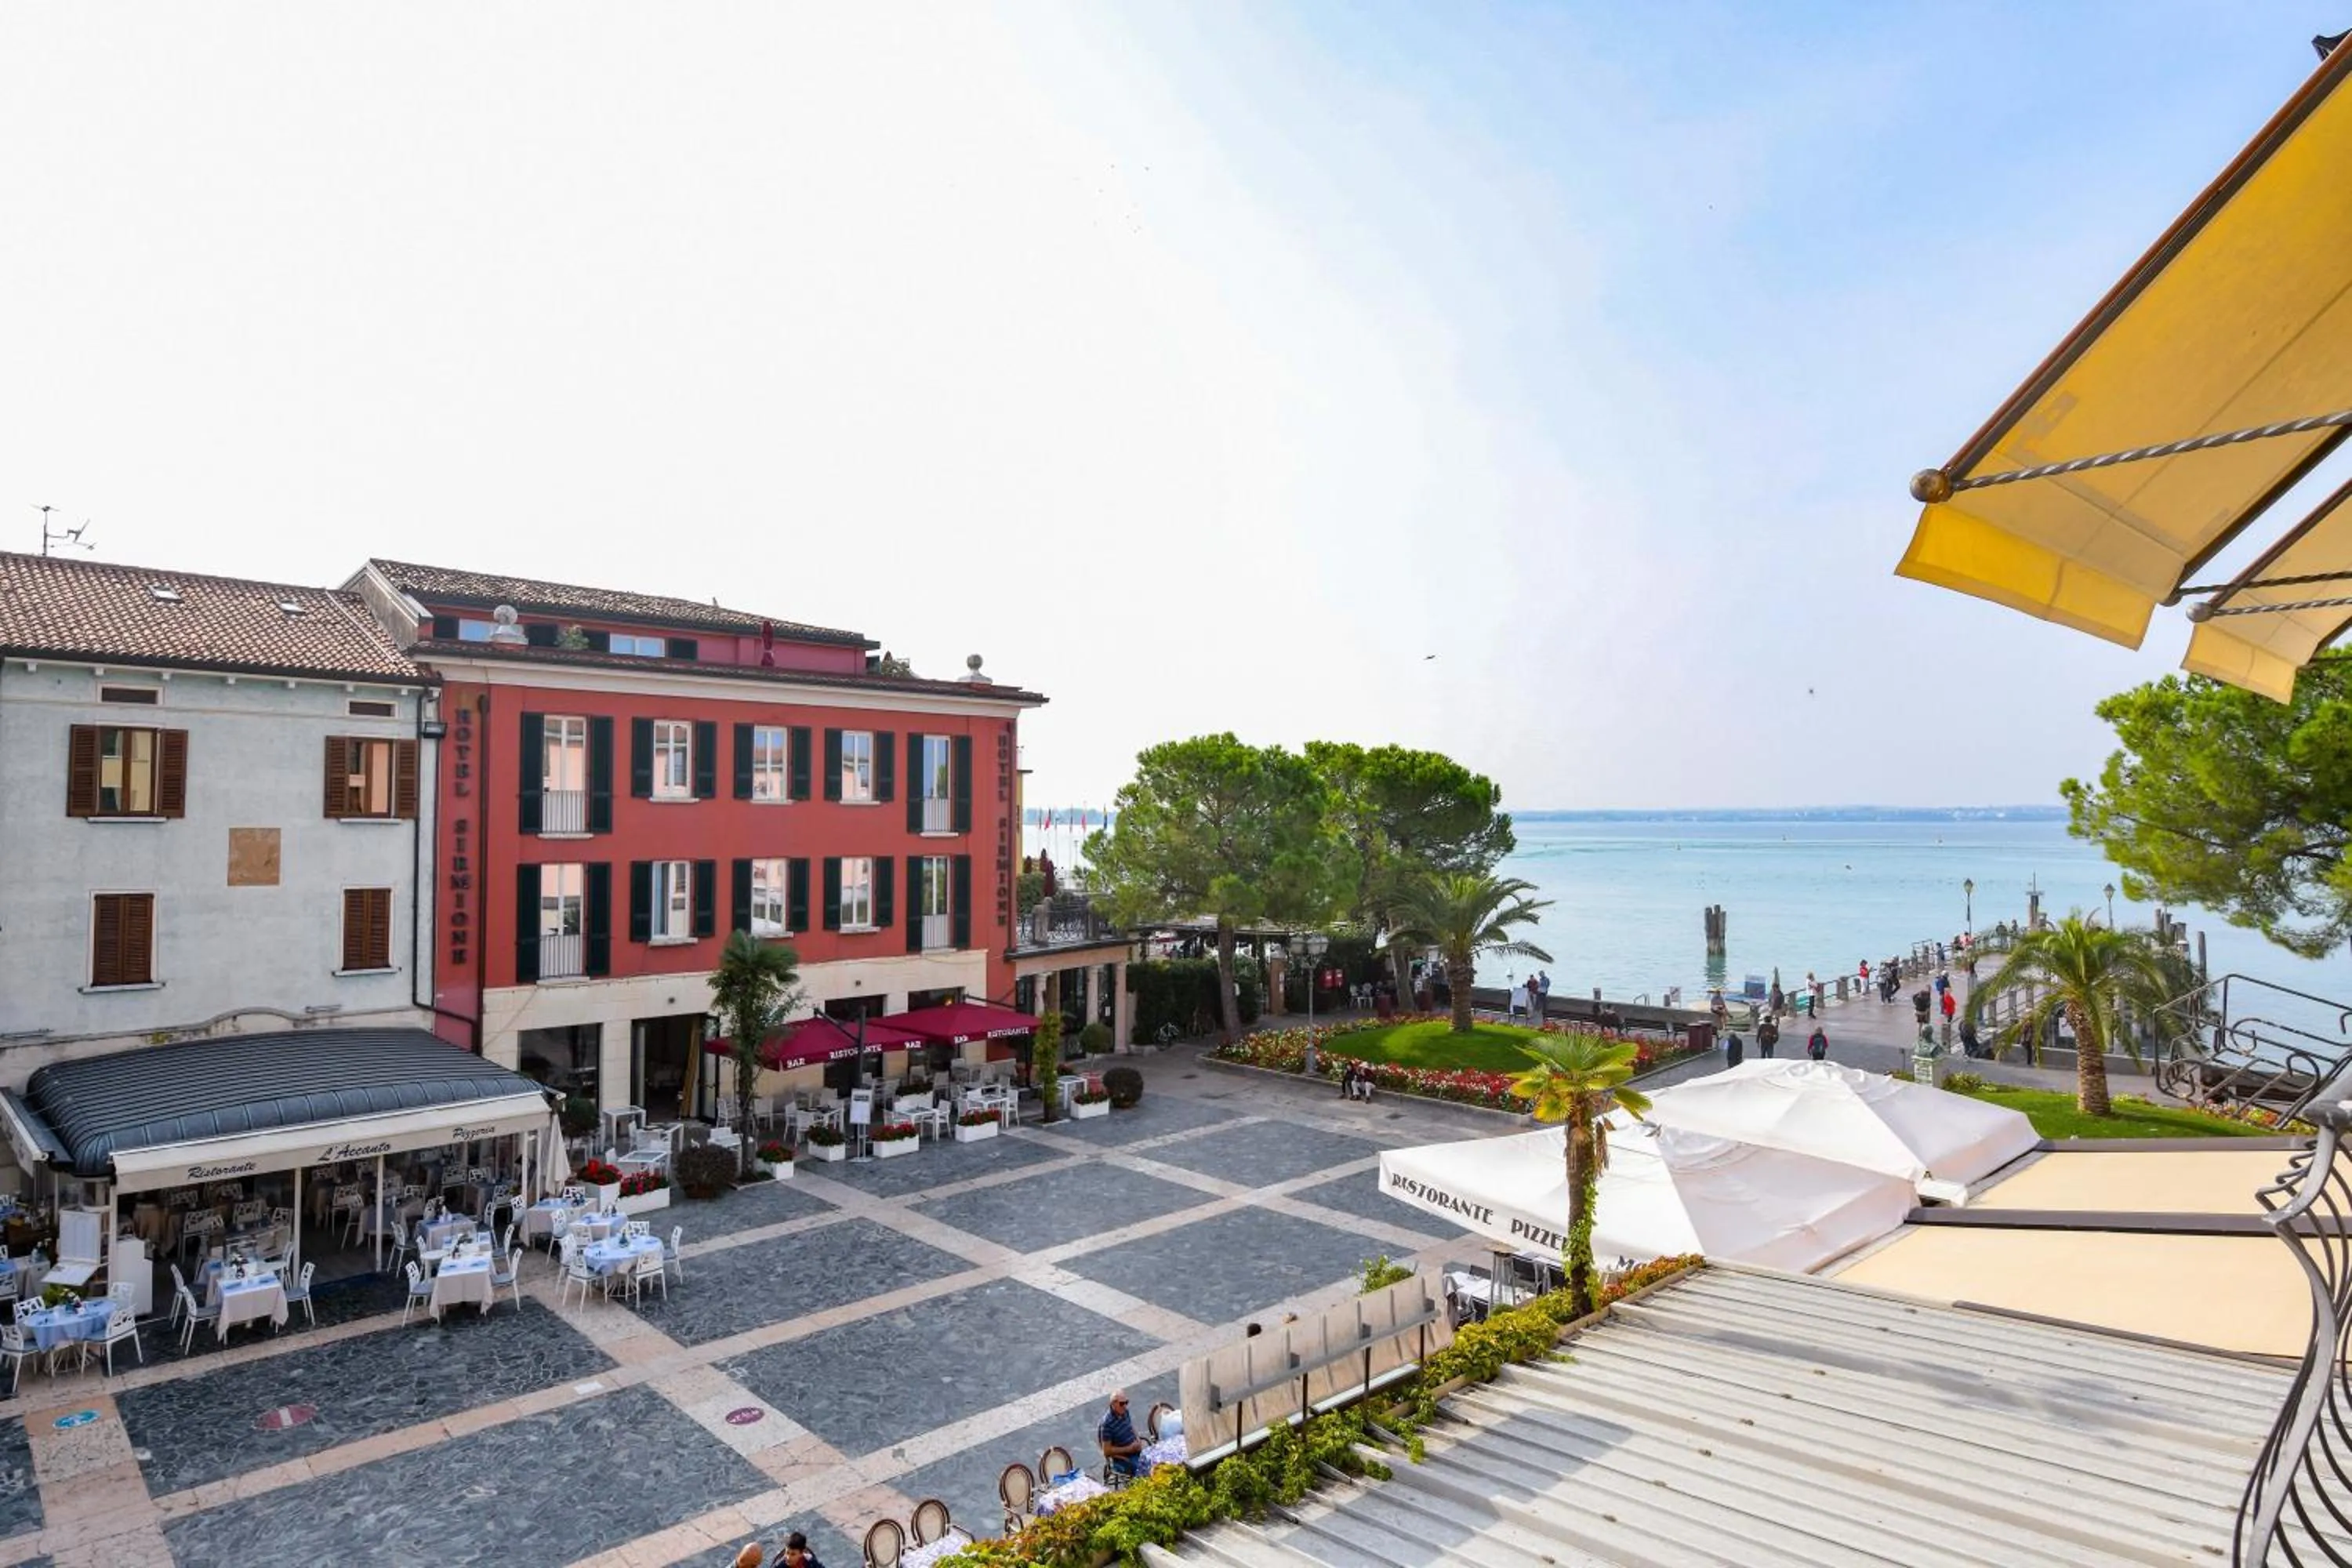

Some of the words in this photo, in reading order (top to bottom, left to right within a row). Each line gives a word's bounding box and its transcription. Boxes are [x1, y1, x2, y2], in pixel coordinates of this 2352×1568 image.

[786, 1058, 806, 1069] BAR
[187, 1161, 256, 1179] Ristorante
[318, 1142, 390, 1161] L'Accanto
[452, 1126, 495, 1141] Pizzeria
[1392, 1172, 1494, 1225] RISTORANTE
